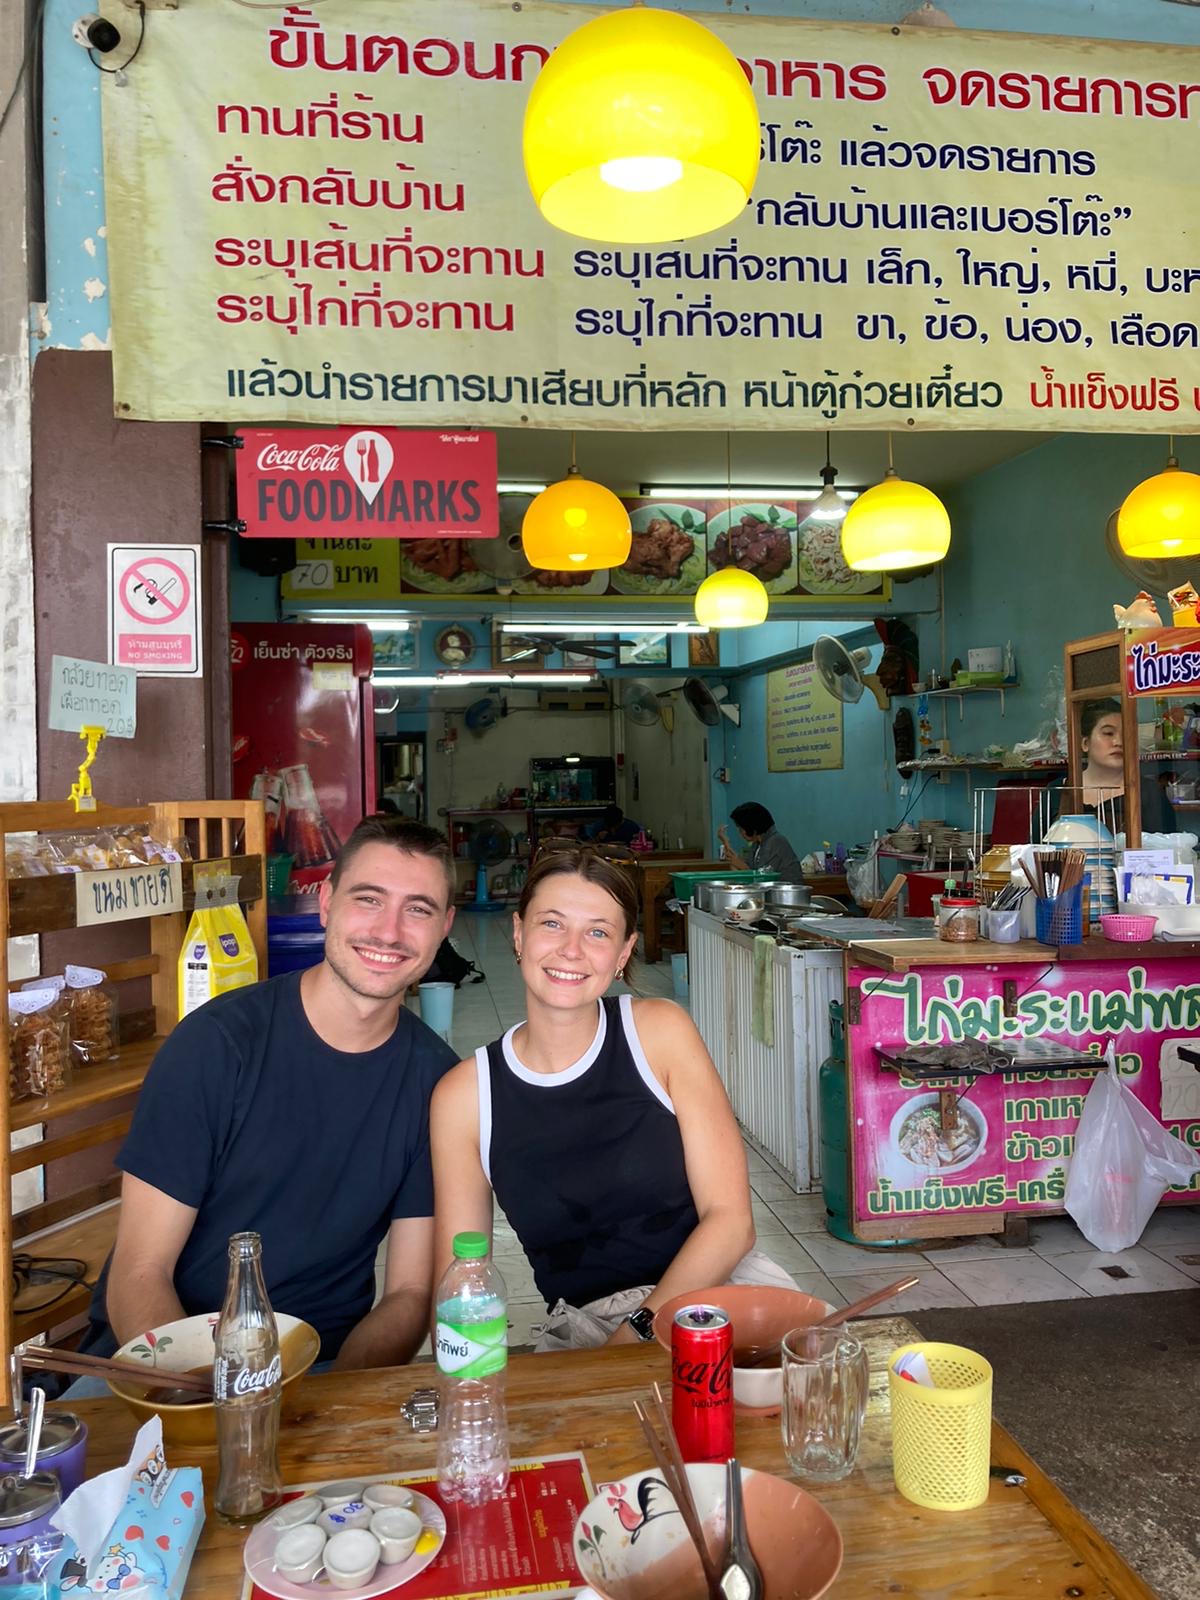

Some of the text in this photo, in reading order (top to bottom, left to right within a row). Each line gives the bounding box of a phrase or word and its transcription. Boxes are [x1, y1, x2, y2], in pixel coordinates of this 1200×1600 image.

[269, 7, 557, 82] ขั้นตอนก
[736, 57, 887, 101] าหาร
[217, 93, 424, 144] ทานที่ร้าน
[760, 120, 1096, 177] โต๊ะ แล้วจดรายการ
[212, 155, 464, 212] สั่งกลับบ้าน
[214, 223, 545, 278] ระบุเส้นที่จะทาน
[867, 248, 943, 289] เล็ก,
[956, 246, 1050, 295] ใหญ่,
[1067, 251, 1128, 296] หมี่,
[216, 282, 515, 335] ระบุไก่ที่จะทาน
[575, 293, 822, 346] ระบุไก่ที่จะทาน
[857, 313, 906, 345] ขา,
[925, 299, 989, 345] ข้อ,
[1005, 302, 1093, 348] น่อง,
[227, 358, 727, 408] แล้วนำรายการมาเสียบที่หลัก
[744, 363, 1003, 419] หน้าตู้ก๋วยเตี๋ยว
[1030, 366, 1180, 412] น้ำแข็งฟรี
[336, 566, 378, 584] บาท
[254, 641, 300, 659] เย็นซ่า
[305, 643, 353, 659] ตัวจริง
[1006, 1098, 1087, 1122] เกาเห
